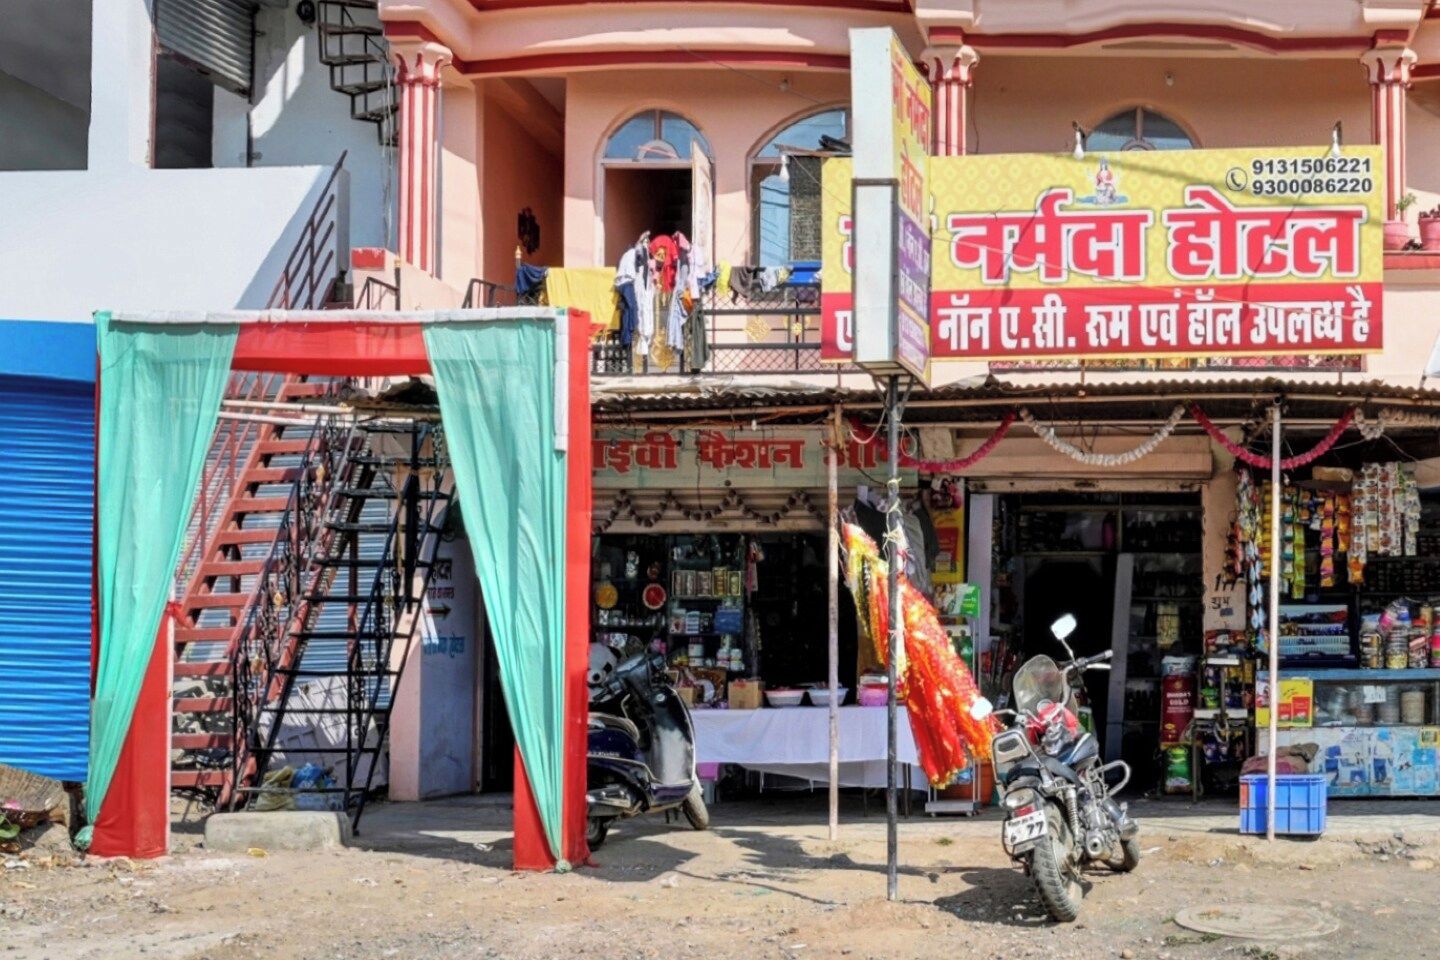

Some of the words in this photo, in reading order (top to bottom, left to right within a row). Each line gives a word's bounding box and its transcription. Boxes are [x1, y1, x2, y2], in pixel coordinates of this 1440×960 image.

[1252, 157, 1371, 174] 9131506221
[1252, 177, 1372, 195] 9300086220
[950, 186, 1152, 281] नर्मदा
[1165, 187, 1365, 277] होटल
[937, 293, 992, 350] नॉन
[998, 293, 1077, 349] ए.सी.
[1084, 304, 1132, 347] रूम
[1138, 288, 1180, 345] एवं
[1187, 288, 1243, 345] हॉल
[1249, 300, 1345, 344] उपलब्ध
[1346, 285, 1373, 342] है
